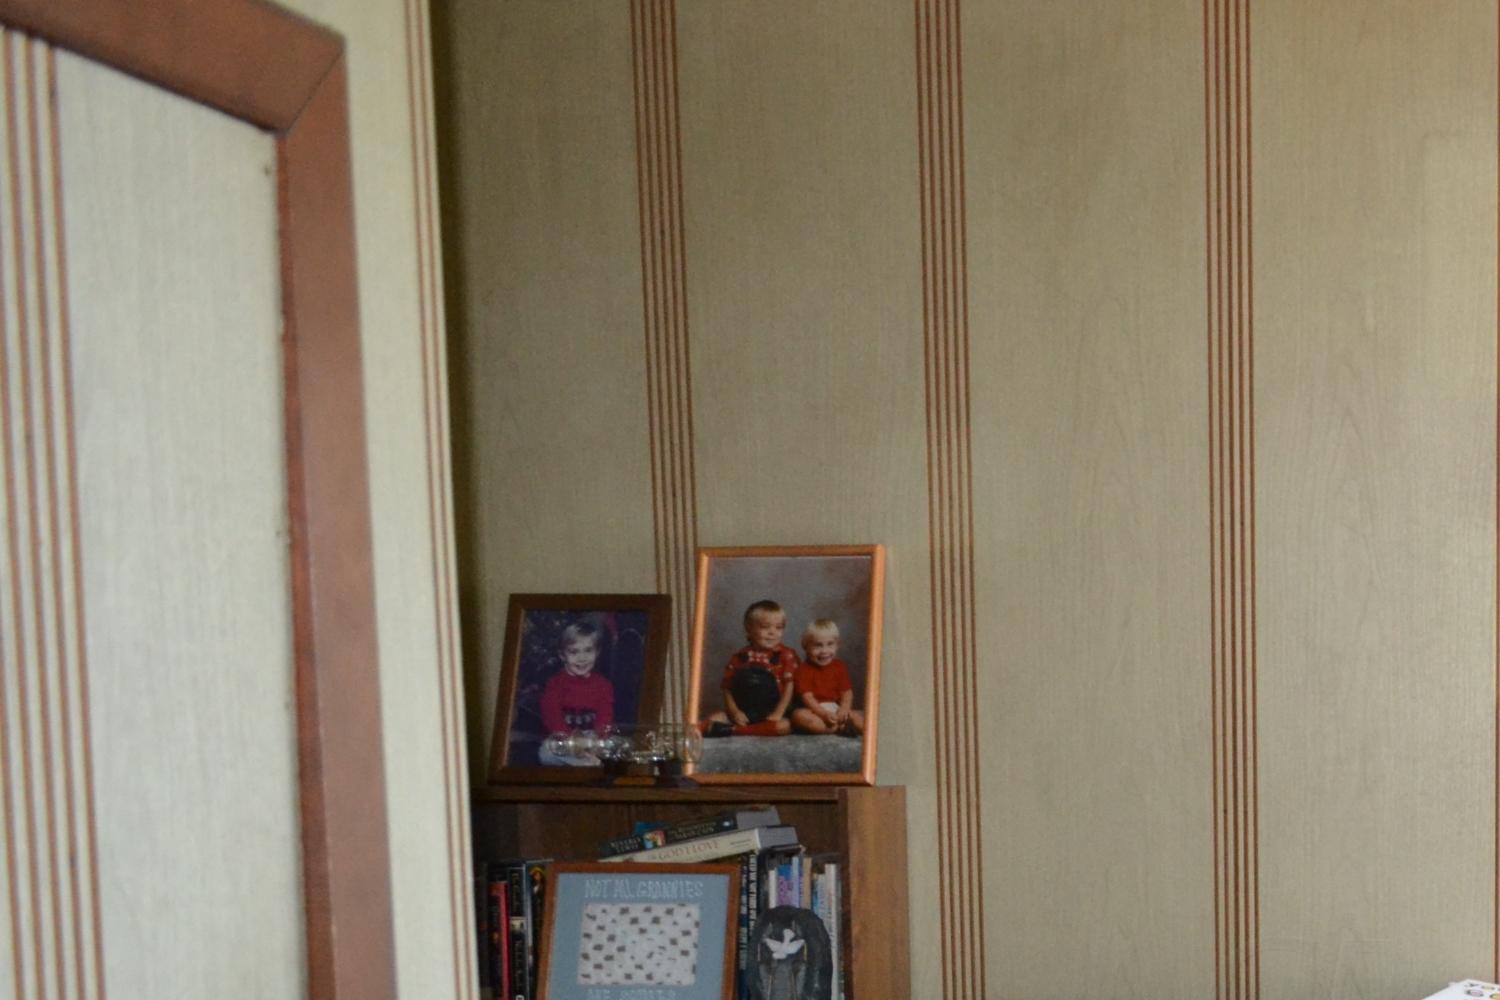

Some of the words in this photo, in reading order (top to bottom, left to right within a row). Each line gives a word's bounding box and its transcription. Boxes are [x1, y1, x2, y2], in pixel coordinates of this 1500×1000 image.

[584, 879, 609, 899] NOT
[613, 879, 635, 899] ALL
[636, 879, 704, 899] GRANNIES
